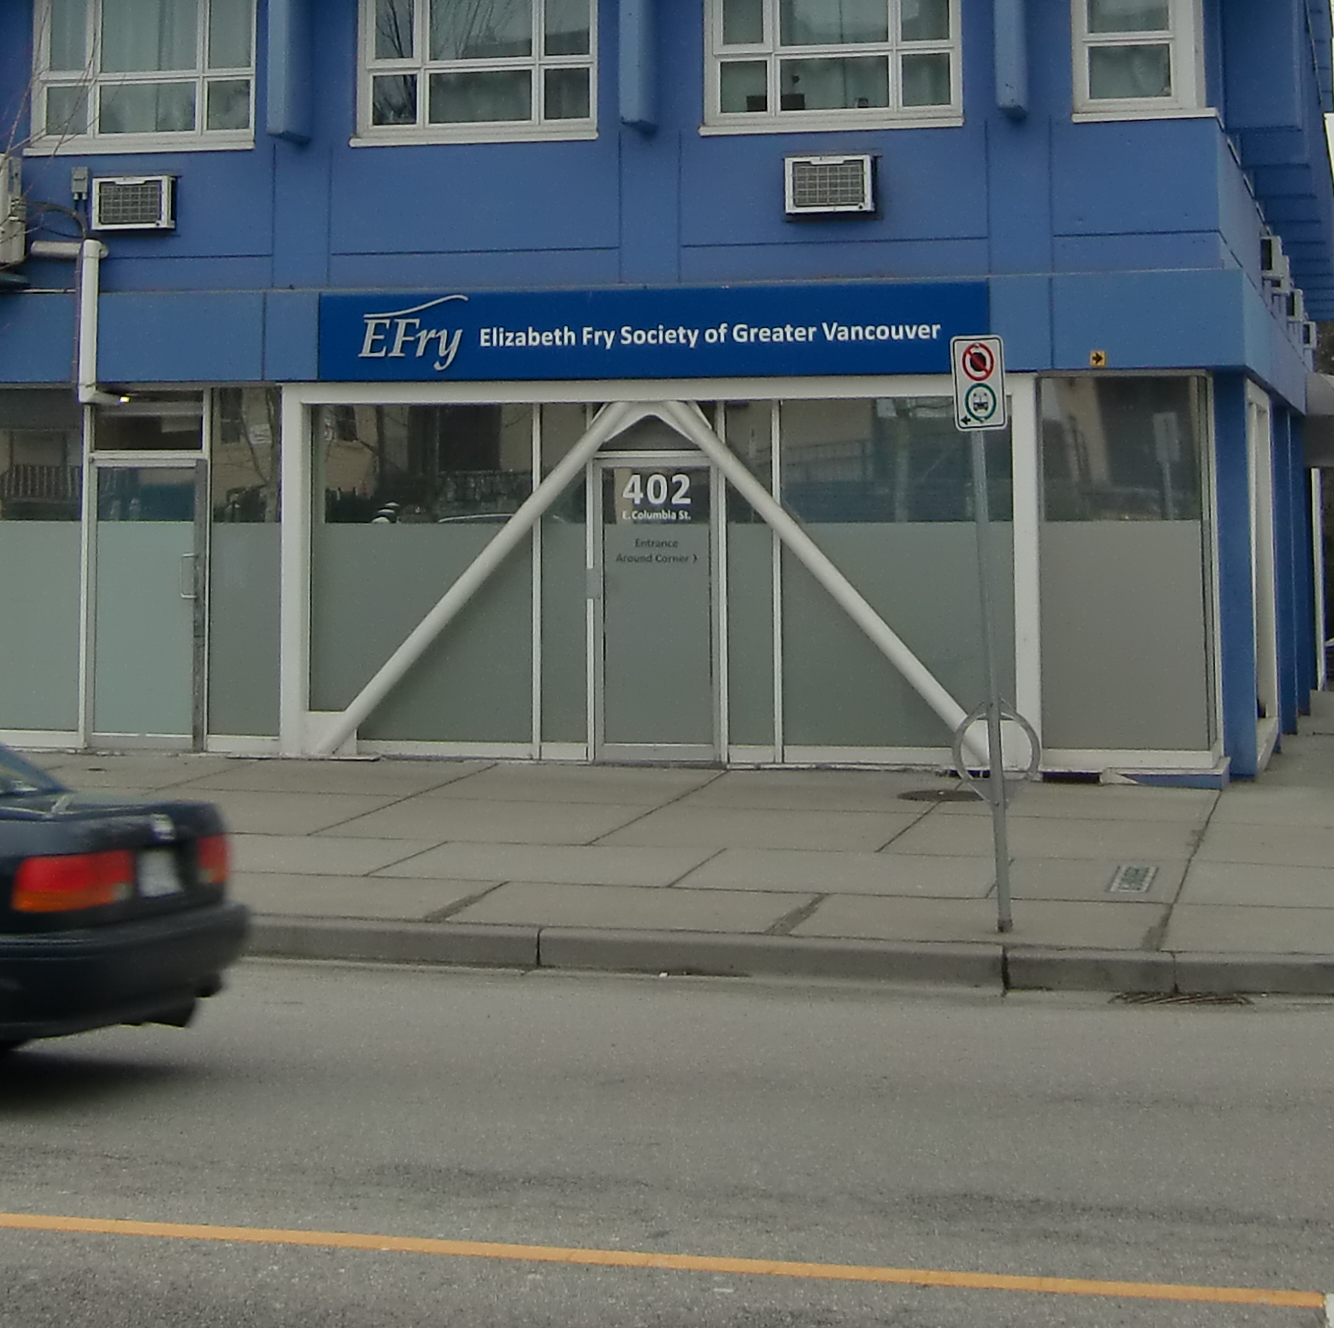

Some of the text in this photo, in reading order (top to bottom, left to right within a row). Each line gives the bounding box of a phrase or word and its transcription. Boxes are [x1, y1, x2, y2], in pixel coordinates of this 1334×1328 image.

[357, 318, 464, 371] EFry
[479, 322, 941, 349] Elizabeth Fry Society of Greater Vancouver
[622, 474, 692, 505] 402
[631, 509, 677, 520] Columbia
[634, 537, 679, 548] Entrance
[615, 553, 689, 563] Around Corner
